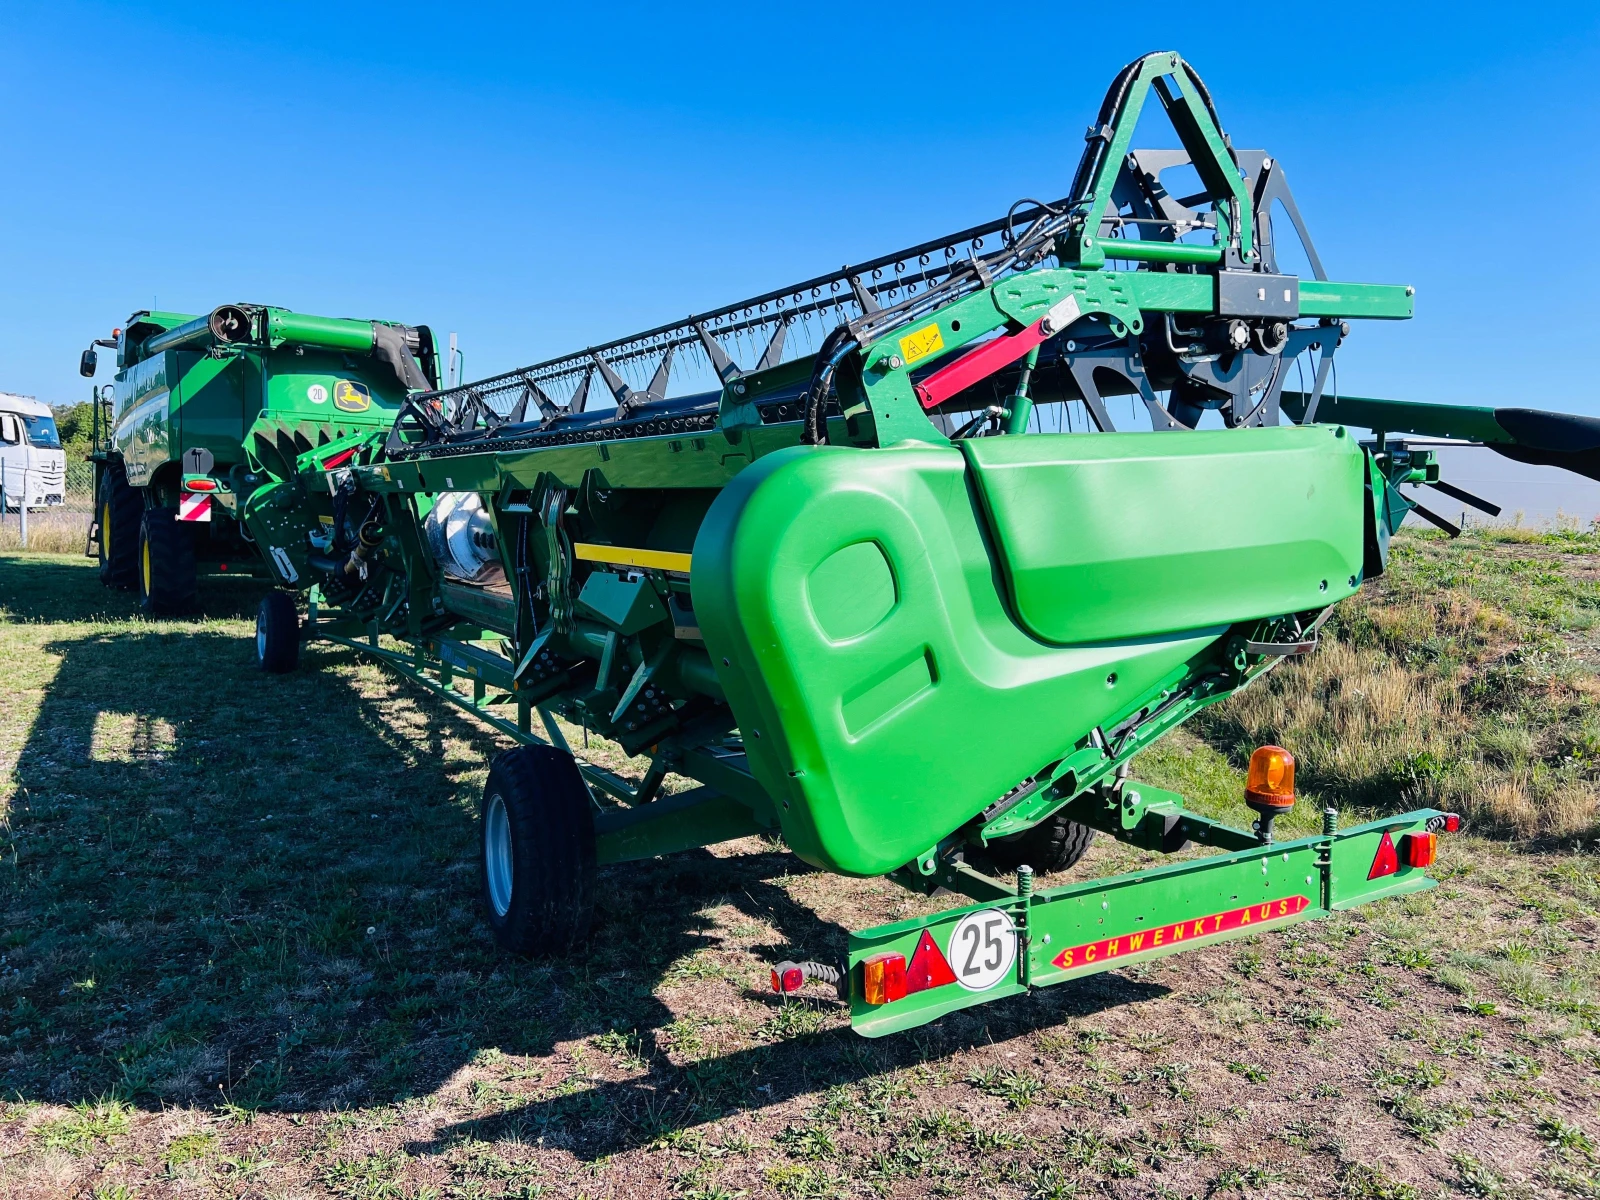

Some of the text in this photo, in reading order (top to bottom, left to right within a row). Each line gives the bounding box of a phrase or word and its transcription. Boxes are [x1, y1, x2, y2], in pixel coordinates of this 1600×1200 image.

[313, 388, 323, 400] 20
[962, 918, 1003, 977] 25
[1062, 897, 1302, 967] SCHWENKT AUS!
